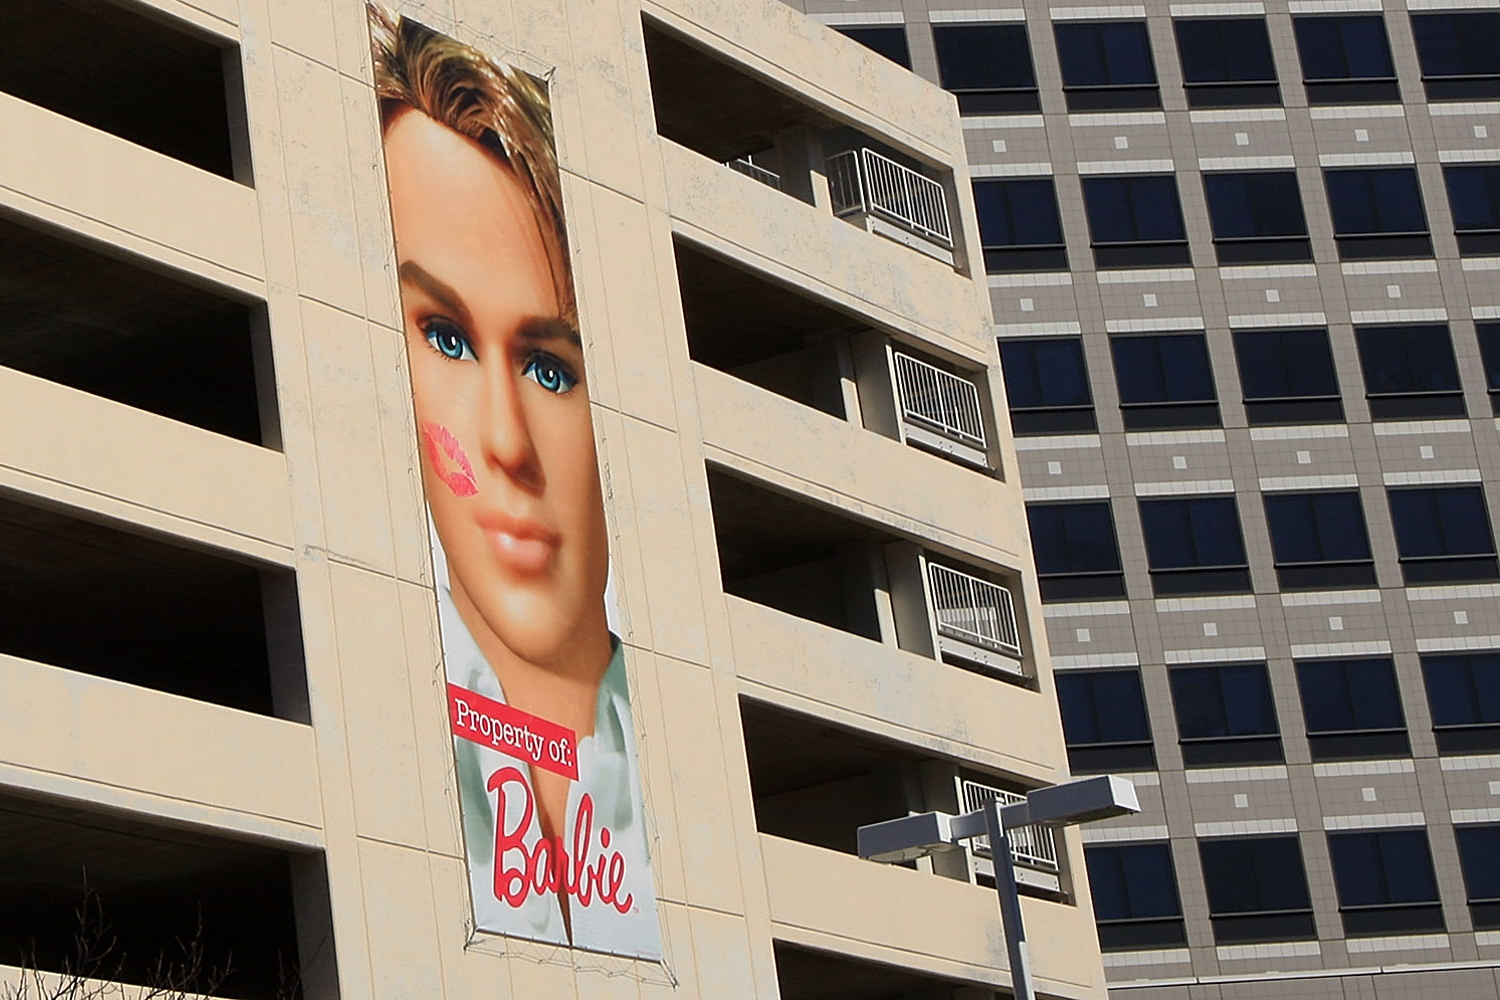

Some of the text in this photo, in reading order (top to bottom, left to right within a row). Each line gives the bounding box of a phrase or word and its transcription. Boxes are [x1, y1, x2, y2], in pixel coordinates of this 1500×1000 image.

[453, 697, 573, 767] Property of:
[487, 765, 634, 914] Barbie
